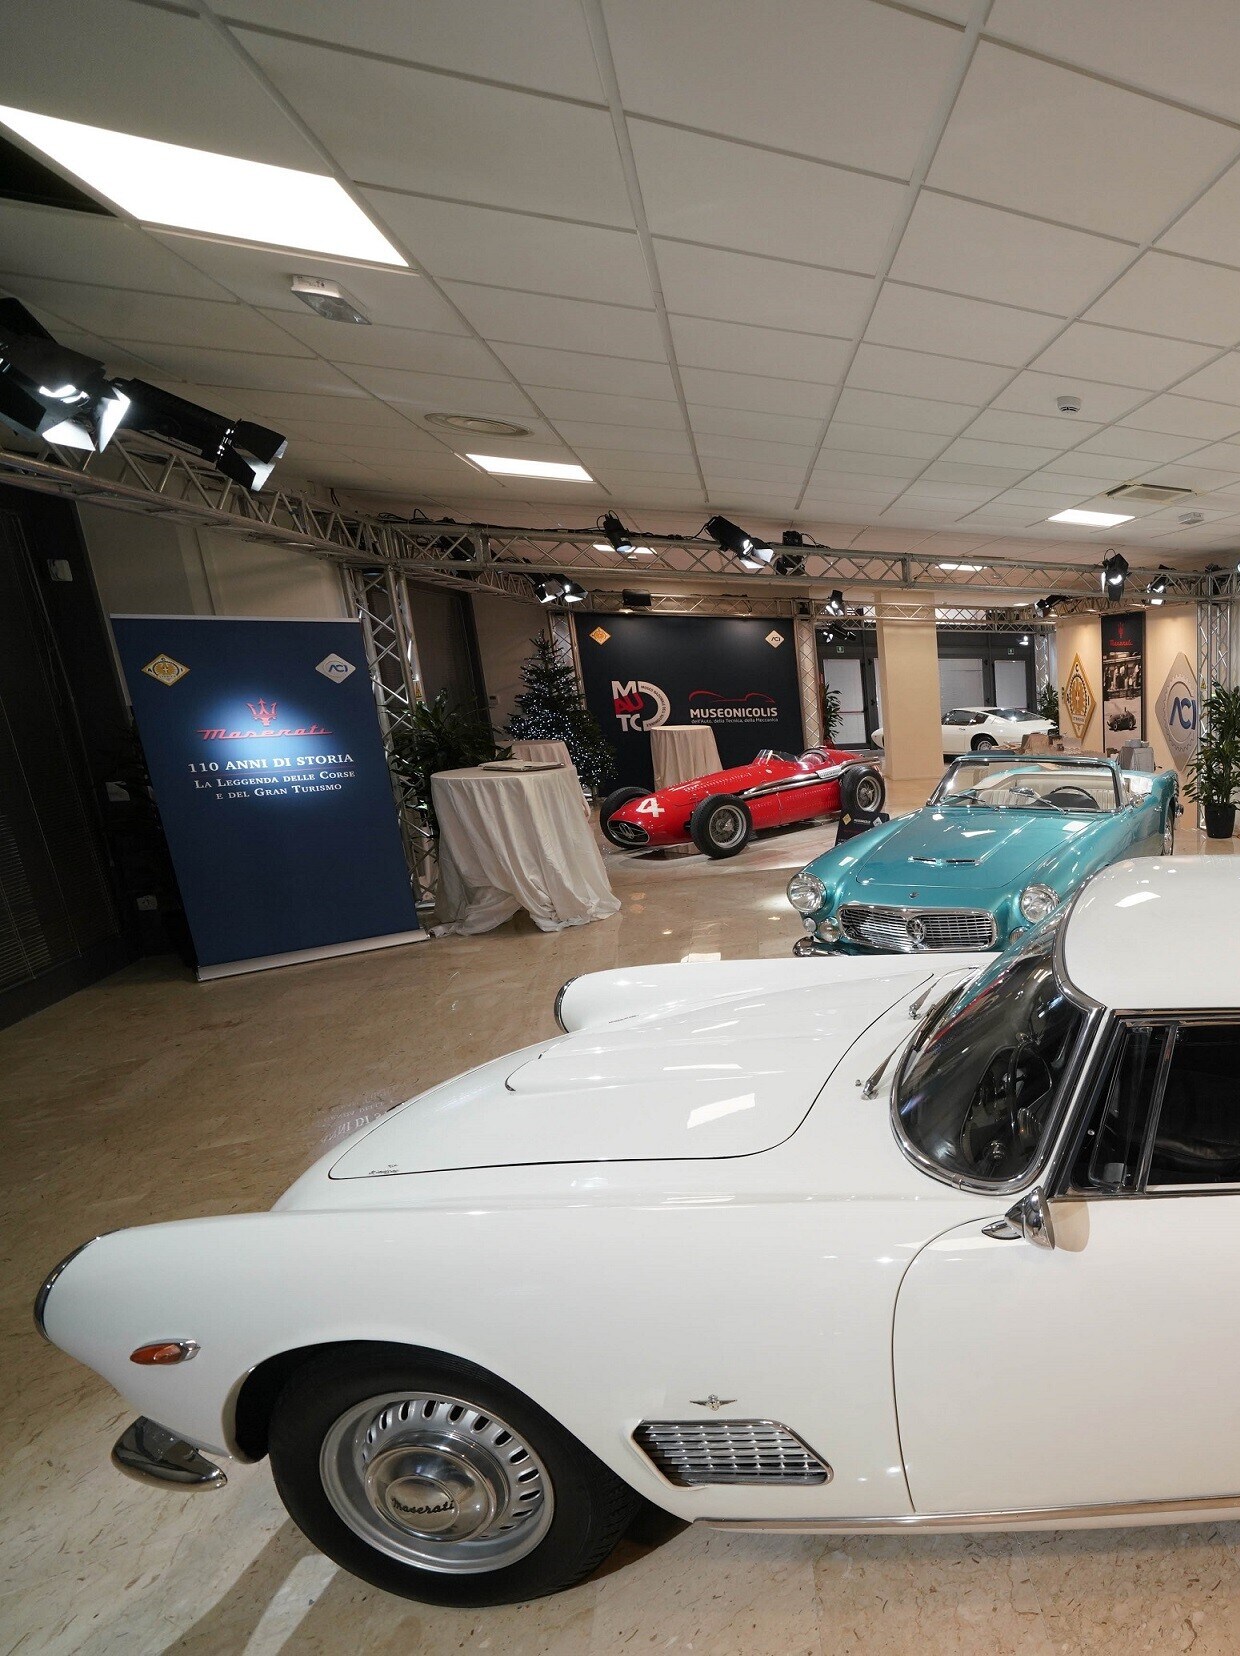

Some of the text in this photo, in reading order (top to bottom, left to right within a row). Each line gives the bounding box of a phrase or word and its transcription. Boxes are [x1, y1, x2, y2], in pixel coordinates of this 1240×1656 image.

[328, 664, 349, 673] ACI
[689, 707, 778, 719] MUSEONICOLIS
[1168, 696, 1197, 731] ACI
[196, 724, 333, 741] Maserati
[187, 753, 354, 773] 110 ANNI DI STORIA
[635, 797, 666, 818] 4
[391, 1497, 455, 1515] Maserati
